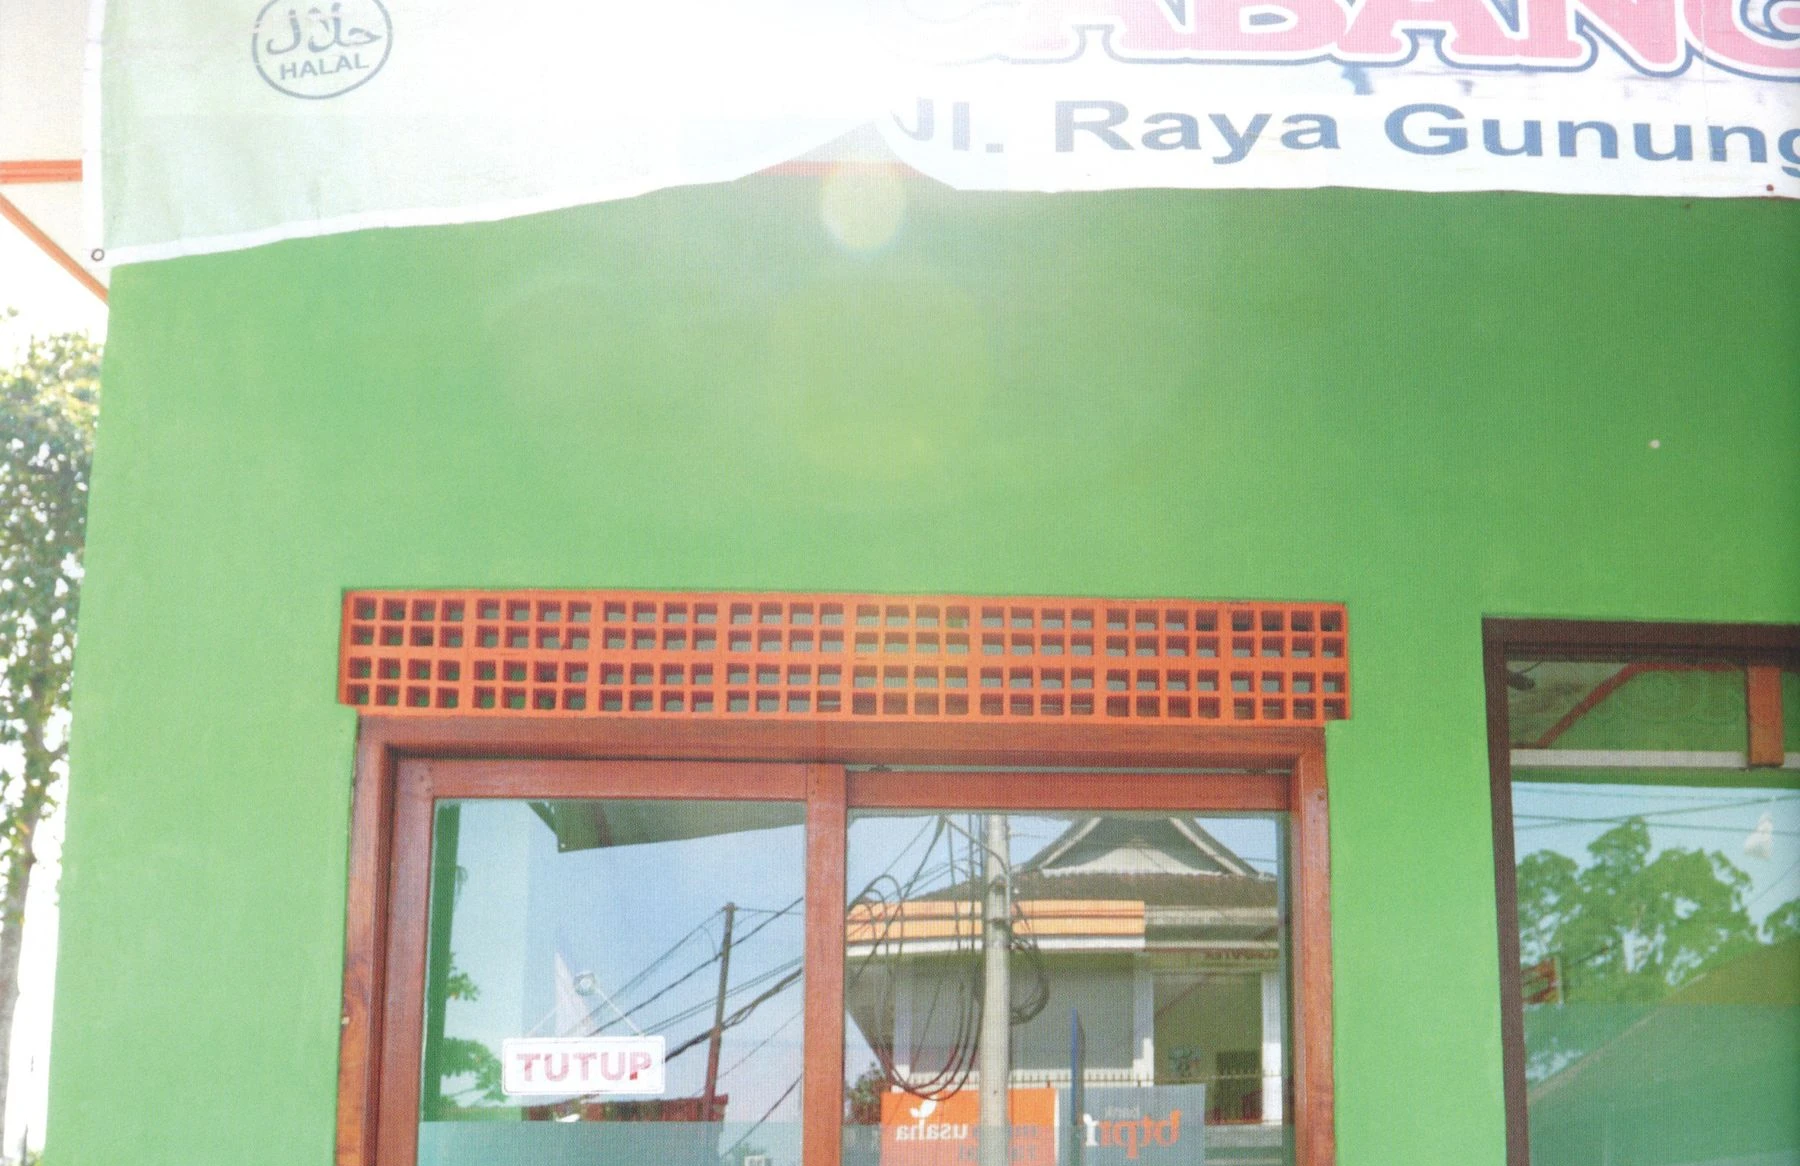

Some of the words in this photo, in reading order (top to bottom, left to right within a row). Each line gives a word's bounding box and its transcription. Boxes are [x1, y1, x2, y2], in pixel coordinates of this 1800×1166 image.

[279, 53, 370, 80] HALAL
[1055, 100, 1340, 165] Raya
[516, 1052, 652, 1082] TUTUP
